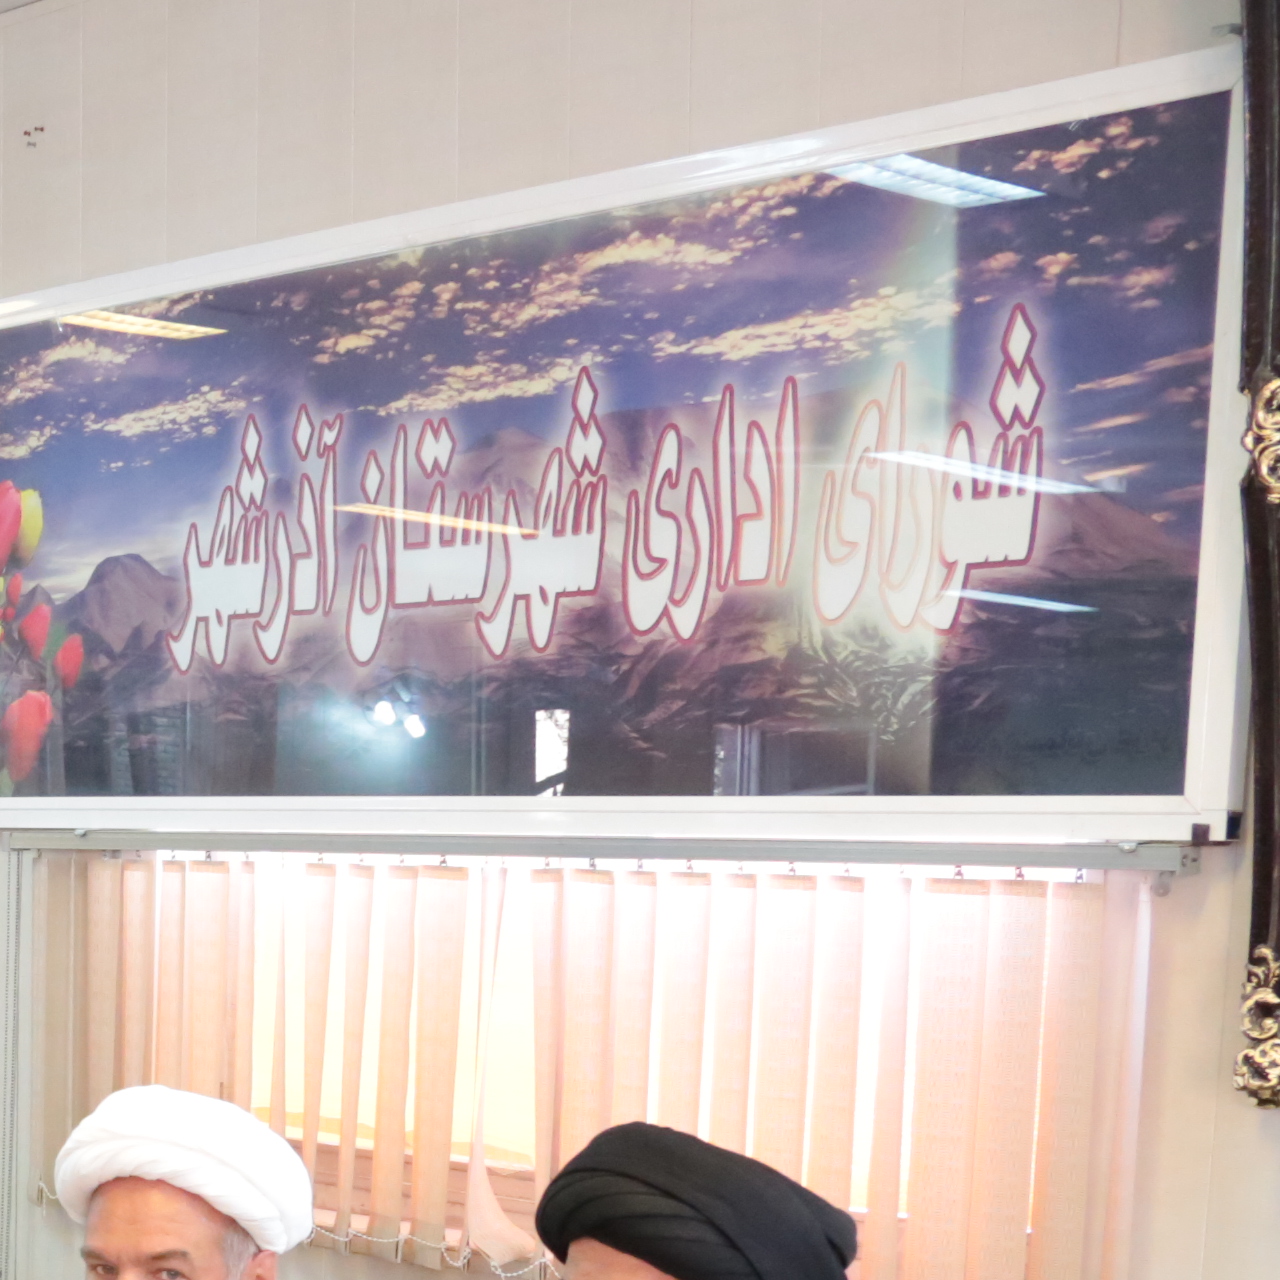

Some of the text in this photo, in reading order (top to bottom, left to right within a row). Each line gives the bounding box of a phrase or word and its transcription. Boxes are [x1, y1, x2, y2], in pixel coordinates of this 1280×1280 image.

[165, 302, 1046, 675] شورای اداری شهرستان آذرشهر
